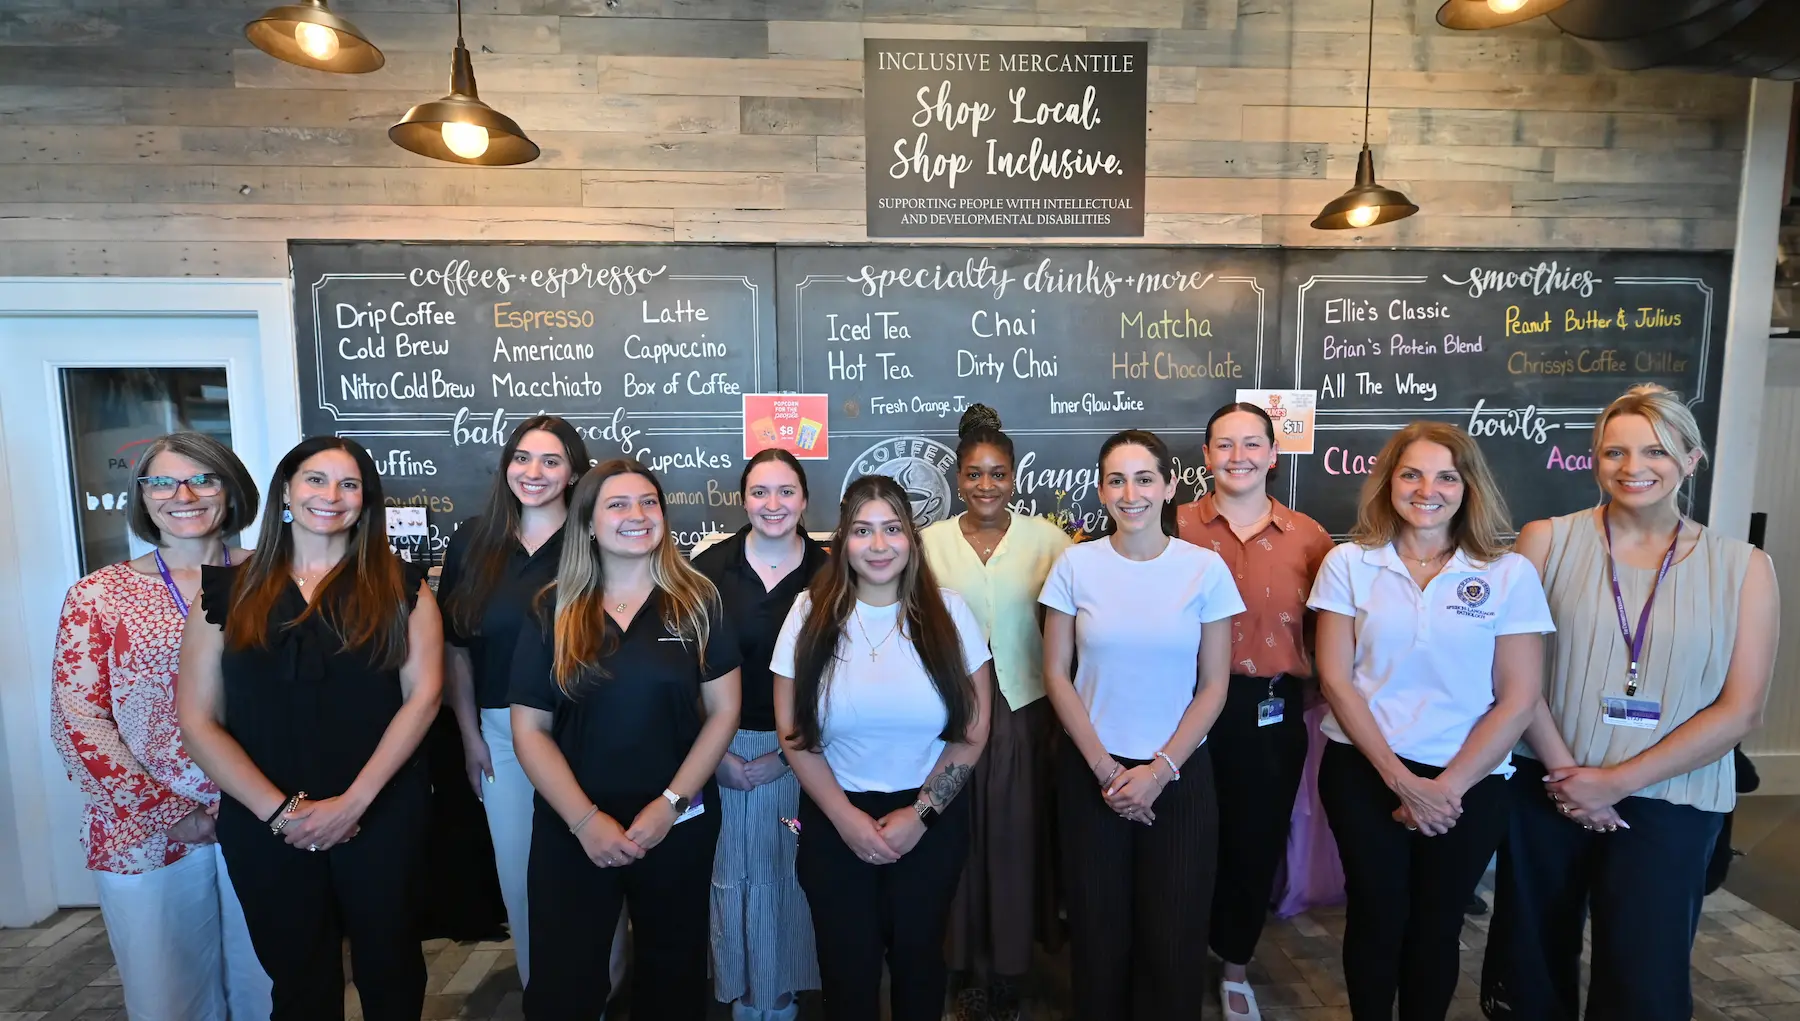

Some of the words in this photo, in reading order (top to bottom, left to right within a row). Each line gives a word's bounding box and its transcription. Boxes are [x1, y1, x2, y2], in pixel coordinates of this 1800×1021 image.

[878, 51, 990, 72] INCLUSIVE
[998, 53, 1135, 74] MERCANTILE
[911, 79, 996, 139] Shop
[1008, 84, 1101, 132] Local.
[889, 131, 973, 190] Shop
[985, 136, 1123, 182] Inclusive.
[878, 197, 957, 209] SUPPORTING
[959, 198, 1004, 210] PEOPLE
[1005, 197, 1041, 210] WITH
[1043, 198, 1133, 210] INTELLECTUAL
[900, 213, 928, 225] AND
[930, 213, 1035, 225] DEVELOPMENTAL
[1037, 213, 1112, 226] DISABILITIES
[846, 256, 1016, 301] specialty
[1442, 260, 1603, 299] smoothies
[335, 301, 387, 335] Drip
[390, 300, 457, 327] Coffee
[494, 301, 594, 332] Espresso
[642, 299, 710, 324] Latte
[971, 308, 1036, 338] Chai
[1121, 308, 1213, 340] Matcha
[1325, 297, 1379, 324] Ellie's
[1388, 298, 1451, 321] Classic
[1505, 305, 1553, 337] Peanut
[1565, 308, 1613, 332] Butter
[1634, 307, 1682, 328] Julius
[825, 312, 871, 342] Iced
[874, 311, 912, 340] Tea
[338, 335, 386, 361] Cold
[395, 332, 449, 358] Brew
[493, 336, 594, 363] Americano
[624, 333, 727, 364] Cappuccino
[1323, 336, 1382, 361] Brian's
[1390, 333, 1437, 356] Protein
[1443, 333, 1483, 355] Blend
[1576, 350, 1628, 373] Coffee
[1633, 353, 1687, 373] Chiller
[827, 349, 867, 382] Hot
[875, 352, 914, 381] Tea
[957, 349, 1005, 384] Dirty
[1012, 347, 1058, 379] Chai
[1112, 350, 1150, 380] Hot
[1154, 351, 1243, 381] Chocolate
[340, 372, 389, 401] Nitro
[390, 371, 429, 400] Cold
[431, 372, 475, 399] Brew
[491, 372, 602, 398] Macchiato
[624, 372, 656, 398] Box
[662, 372, 681, 395] of
[686, 370, 742, 396] Coffee
[1320, 372, 1346, 400] All
[1355, 371, 1384, 395] The
[1395, 376, 1438, 402] Whey
[870, 396, 908, 415] Fresh
[911, 395, 951, 418] Orange
[1050, 394, 1081, 415] Inner
[1081, 395, 1111, 416] Glow
[1112, 390, 1145, 412] Juice
[780, 425, 794, 436] $8
[1283, 419, 1303, 434] $11
[1465, 398, 1563, 446] bowls
[370, 450, 437, 476] uffins
[858, 440, 955, 475] COFFEE
[1546, 446, 1592, 471] Acai
